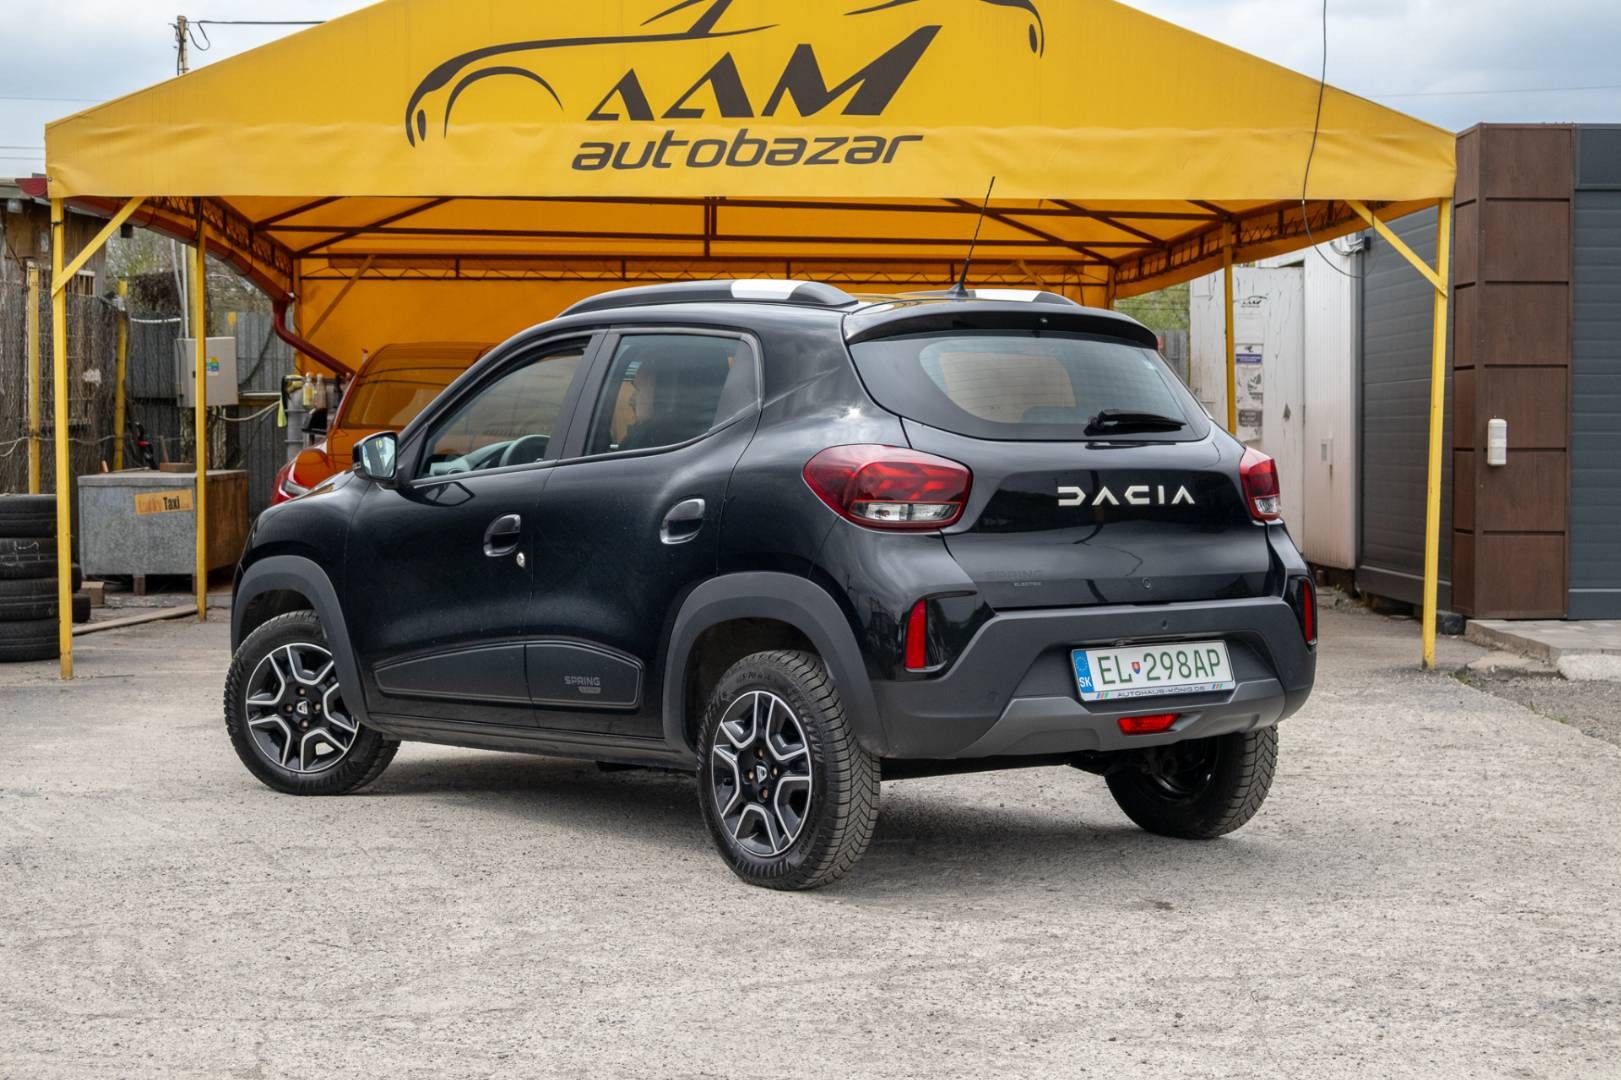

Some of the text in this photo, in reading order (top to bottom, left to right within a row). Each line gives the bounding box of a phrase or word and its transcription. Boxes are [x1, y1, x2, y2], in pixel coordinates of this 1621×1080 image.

[585, 25, 943, 121] AAM
[571, 128, 924, 171] autobazar
[163, 496, 180, 510] Taxi
[1057, 484, 1196, 507] DACIA
[1097, 648, 1221, 685] EL 298AP
[564, 675, 601, 686] SPRING
[1079, 677, 1093, 688] SK
